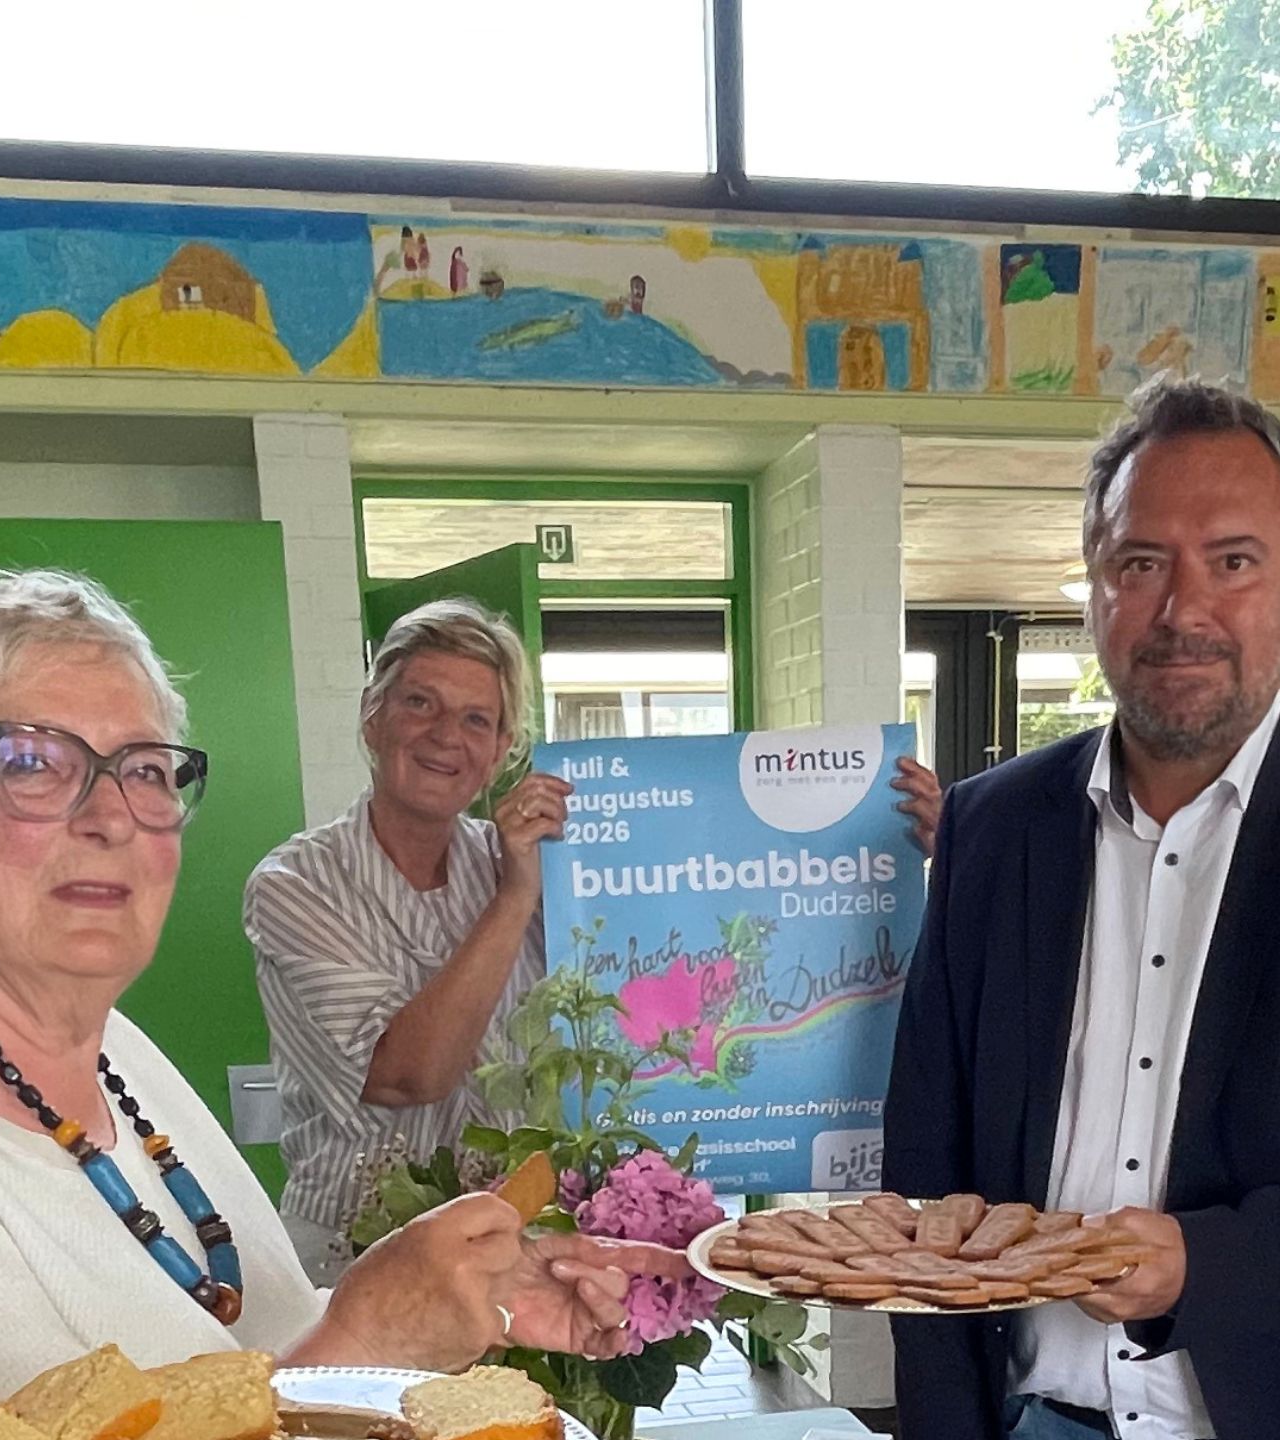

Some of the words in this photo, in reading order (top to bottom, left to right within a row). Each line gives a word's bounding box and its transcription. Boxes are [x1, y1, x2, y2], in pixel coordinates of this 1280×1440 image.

[562, 755, 604, 782] juli
[609, 757, 630, 777] &
[754, 748, 866, 773] mintus
[564, 787, 694, 818] augustus
[566, 820, 631, 845] 2026
[572, 846, 897, 898] buurtbabbels
[780, 888, 897, 918] Dudzele
[623, 927, 683, 980] hart
[770, 925, 916, 1022] Dudzele
[596, 1107, 657, 1128] Gtis
[662, 1110, 687, 1124] en
[691, 1104, 762, 1123] zonder
[765, 1098, 884, 1118] inschrijving
[695, 1136, 797, 1156] asisschool
[829, 1143, 883, 1178] bije
